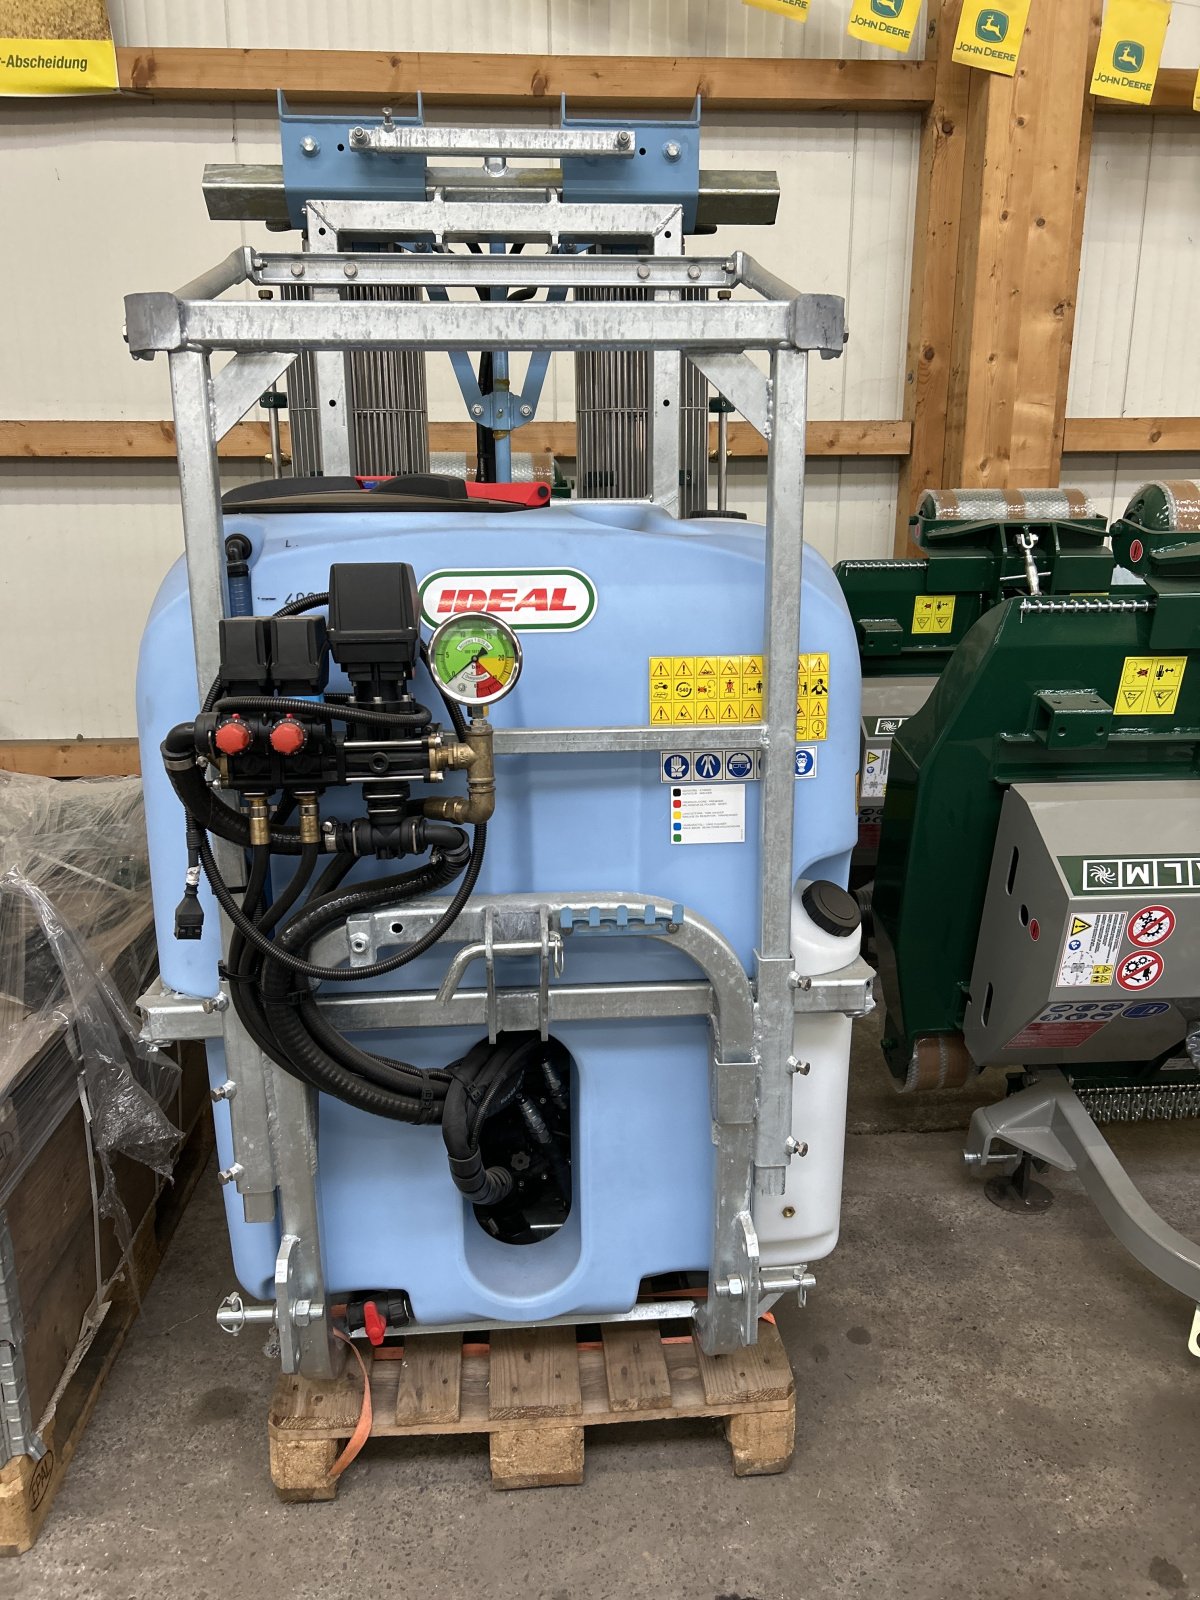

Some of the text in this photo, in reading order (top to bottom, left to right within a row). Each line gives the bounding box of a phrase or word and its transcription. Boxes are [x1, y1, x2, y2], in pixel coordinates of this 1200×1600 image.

[851, 14, 911, 39] JOHN DEERE
[956, 41, 1017, 62] JOHN DEERE
[0, 55, 88, 72] -Abscheidung
[1094, 72, 1153, 91] JOHN DEERE
[437, 588, 577, 613] IDEAL
[445, 651, 450, 659] 5
[1126, 862, 1200, 885] LM
[31, 1459, 53, 1504] EPAL
